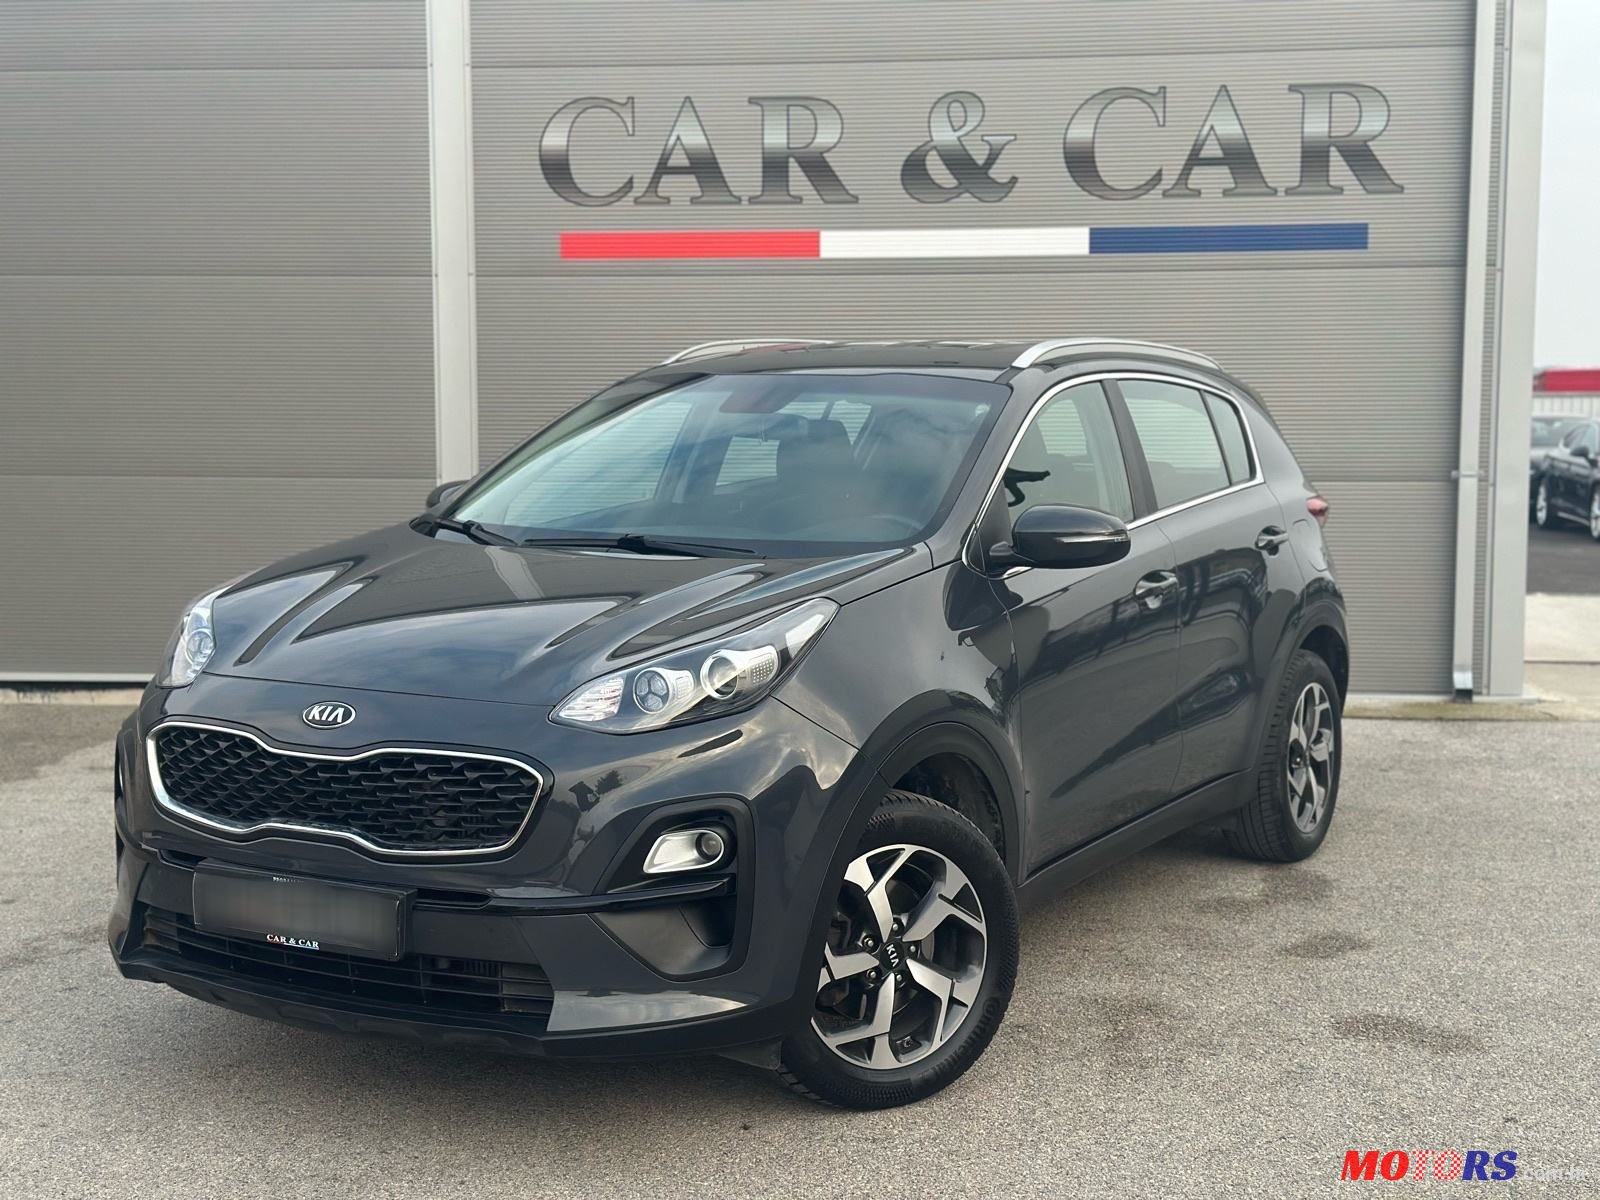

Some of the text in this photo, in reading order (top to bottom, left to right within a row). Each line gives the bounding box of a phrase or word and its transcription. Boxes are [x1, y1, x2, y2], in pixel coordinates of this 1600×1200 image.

[538, 83, 1405, 206] CAR & CAR
[308, 705, 345, 723] KIA
[266, 934, 319, 948] CAR & CAR
[886, 943, 899, 967] KIA
